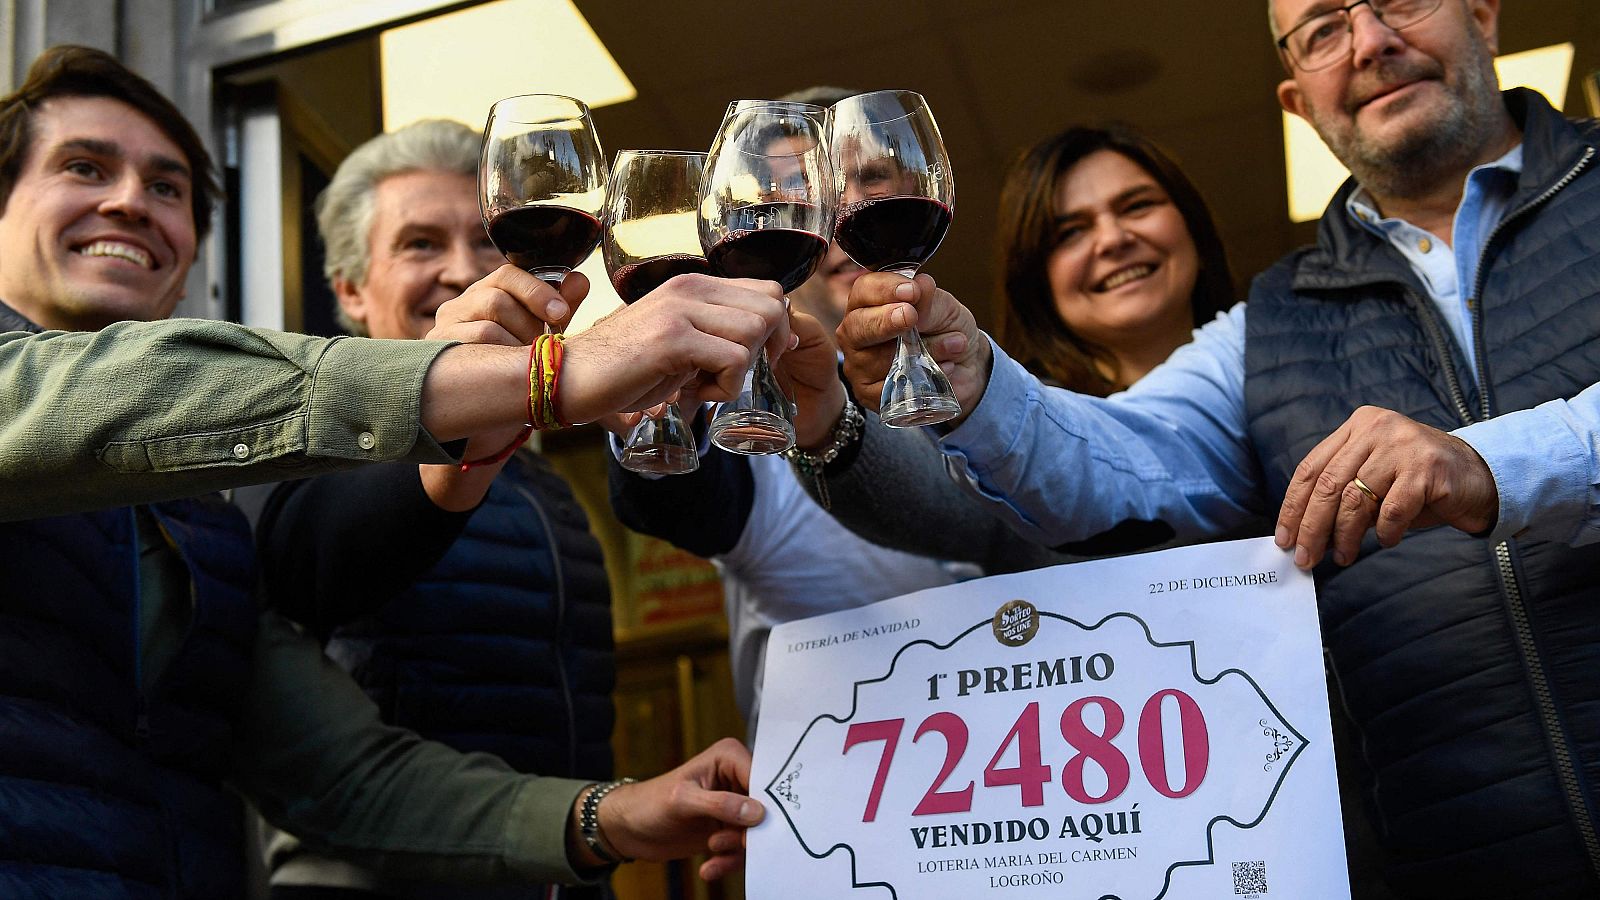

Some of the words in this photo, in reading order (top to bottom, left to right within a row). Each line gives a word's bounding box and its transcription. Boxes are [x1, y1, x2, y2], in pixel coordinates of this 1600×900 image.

[1149, 583, 1164, 594] 22
[1169, 579, 1188, 592] DE
[1193, 571, 1278, 589] DICIEMBRE
[1002, 607, 1031, 627] SORTEO
[1003, 628, 1016, 639] NOS
[1016, 620, 1032, 633] UNE
[788, 634, 839, 653] LOTERÍA
[843, 631, 859, 643] DE
[862, 618, 921, 639] NAVIDAD
[957, 652, 1115, 697] PREMIO
[842, 688, 1210, 823] 72480
[910, 817, 1050, 849] VENDIDO
[1058, 803, 1142, 843] AQUÍ
[918, 859, 980, 873] LOTERIA
[984, 854, 1034, 868] MARIA
[1038, 851, 1068, 865] DEL
[1071, 847, 1138, 862] CARMEN
[990, 870, 1064, 888] LOGROÑO
